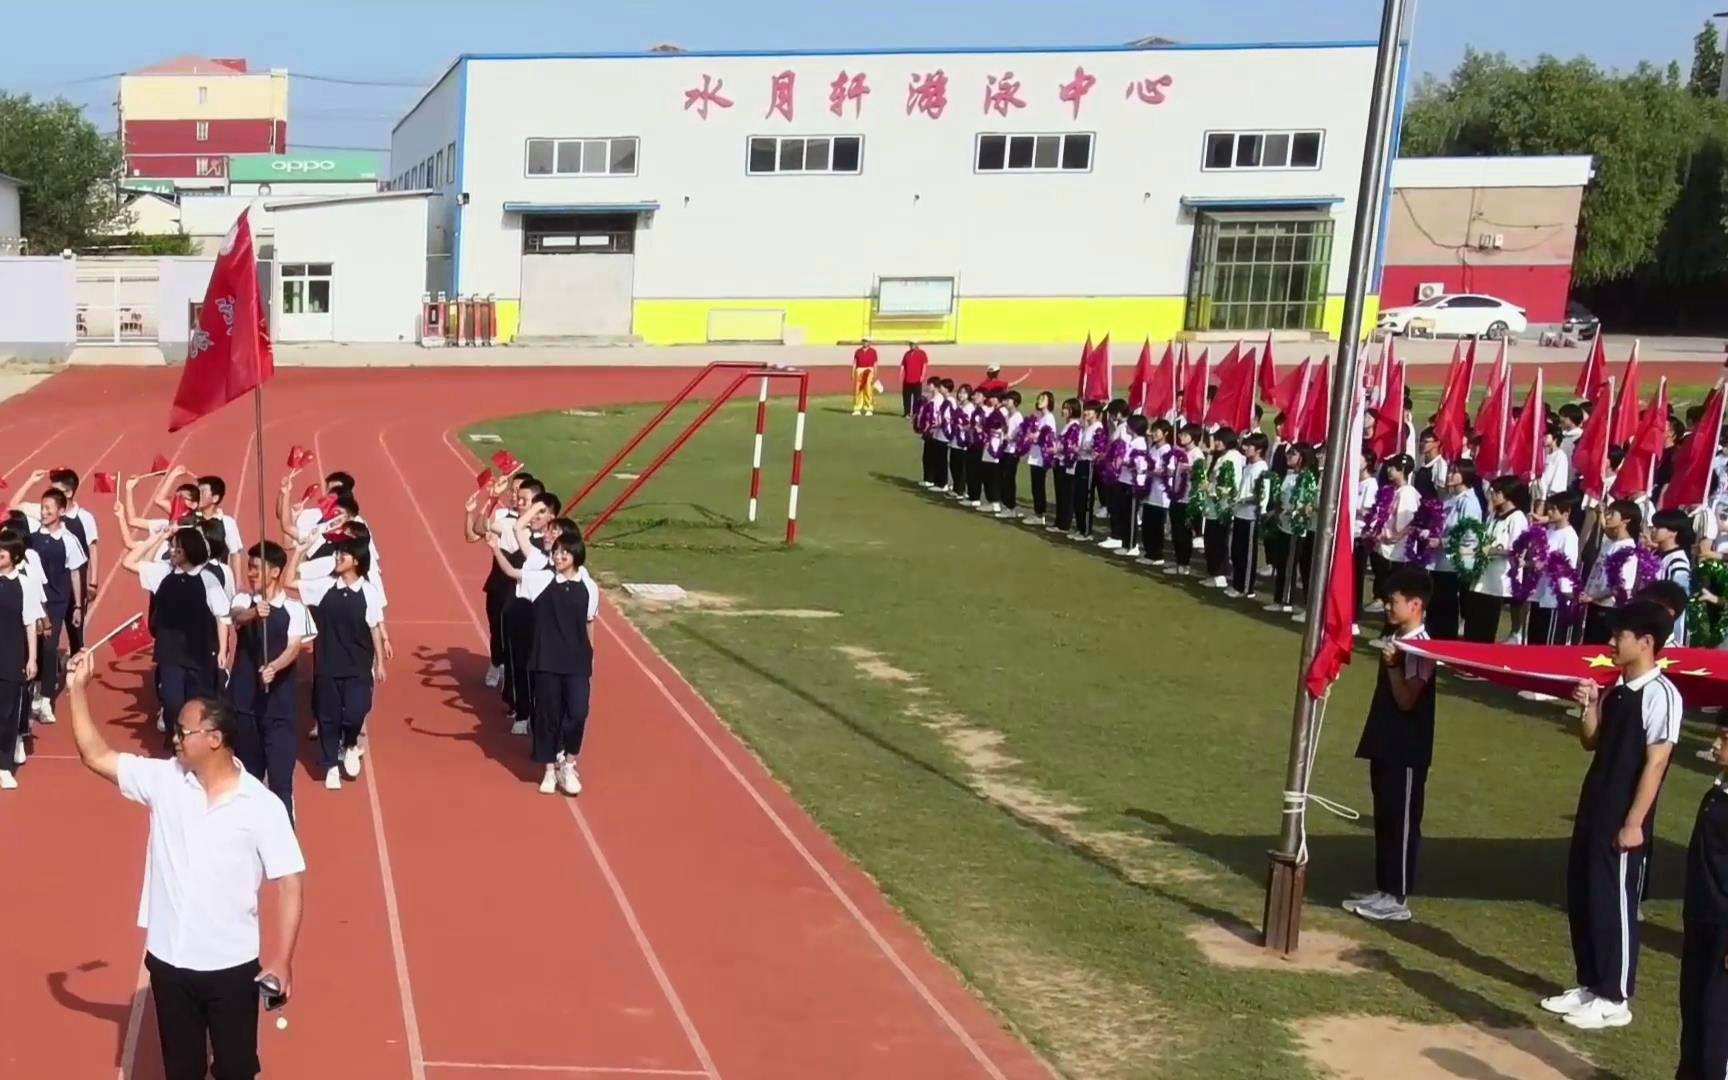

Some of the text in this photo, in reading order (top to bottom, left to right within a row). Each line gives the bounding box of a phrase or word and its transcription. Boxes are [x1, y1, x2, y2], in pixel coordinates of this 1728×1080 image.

[684, 66, 1172, 121] 水月轩游泳中心
